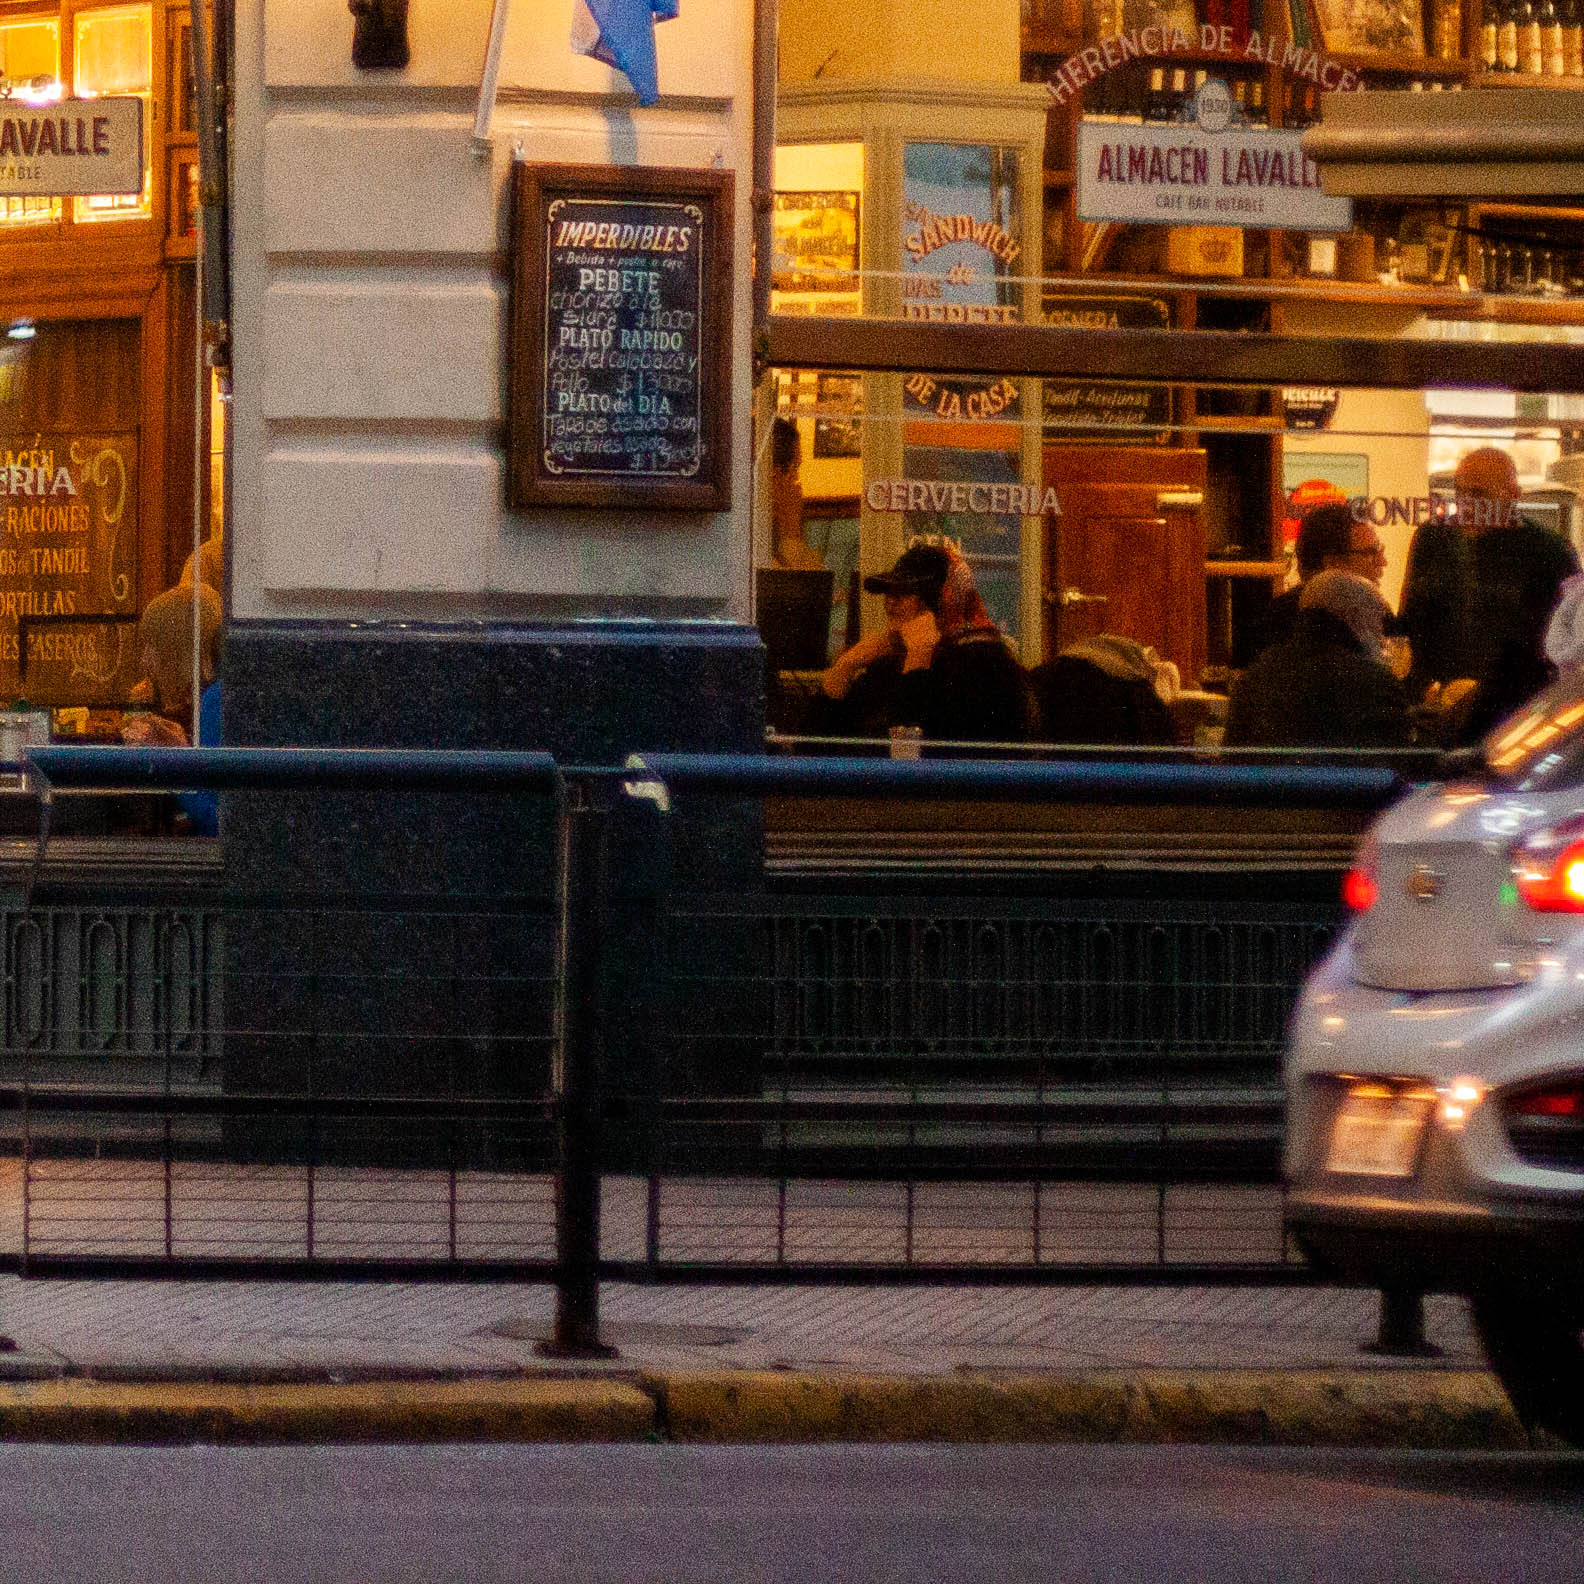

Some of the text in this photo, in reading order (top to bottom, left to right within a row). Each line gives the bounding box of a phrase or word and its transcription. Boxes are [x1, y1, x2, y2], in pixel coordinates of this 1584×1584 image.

[1044, 25, 1190, 106] HERENCIA
[1200, 23, 1235, 52] DE
[1096, 139, 1323, 189] ALMACÉN LAVALL
[555, 220, 693, 253] IMPERDIBLES
[905, 214, 1021, 264] SANDWICH
[578, 268, 662, 294] PEBETE
[558, 326, 614, 348] PLATO
[557, 391, 611, 413] PLATO
[906, 373, 937, 405] DE
[936, 389, 962, 417] LA
[966, 377, 1019, 418] CASA
[31, 541, 90, 575] TANDIL
